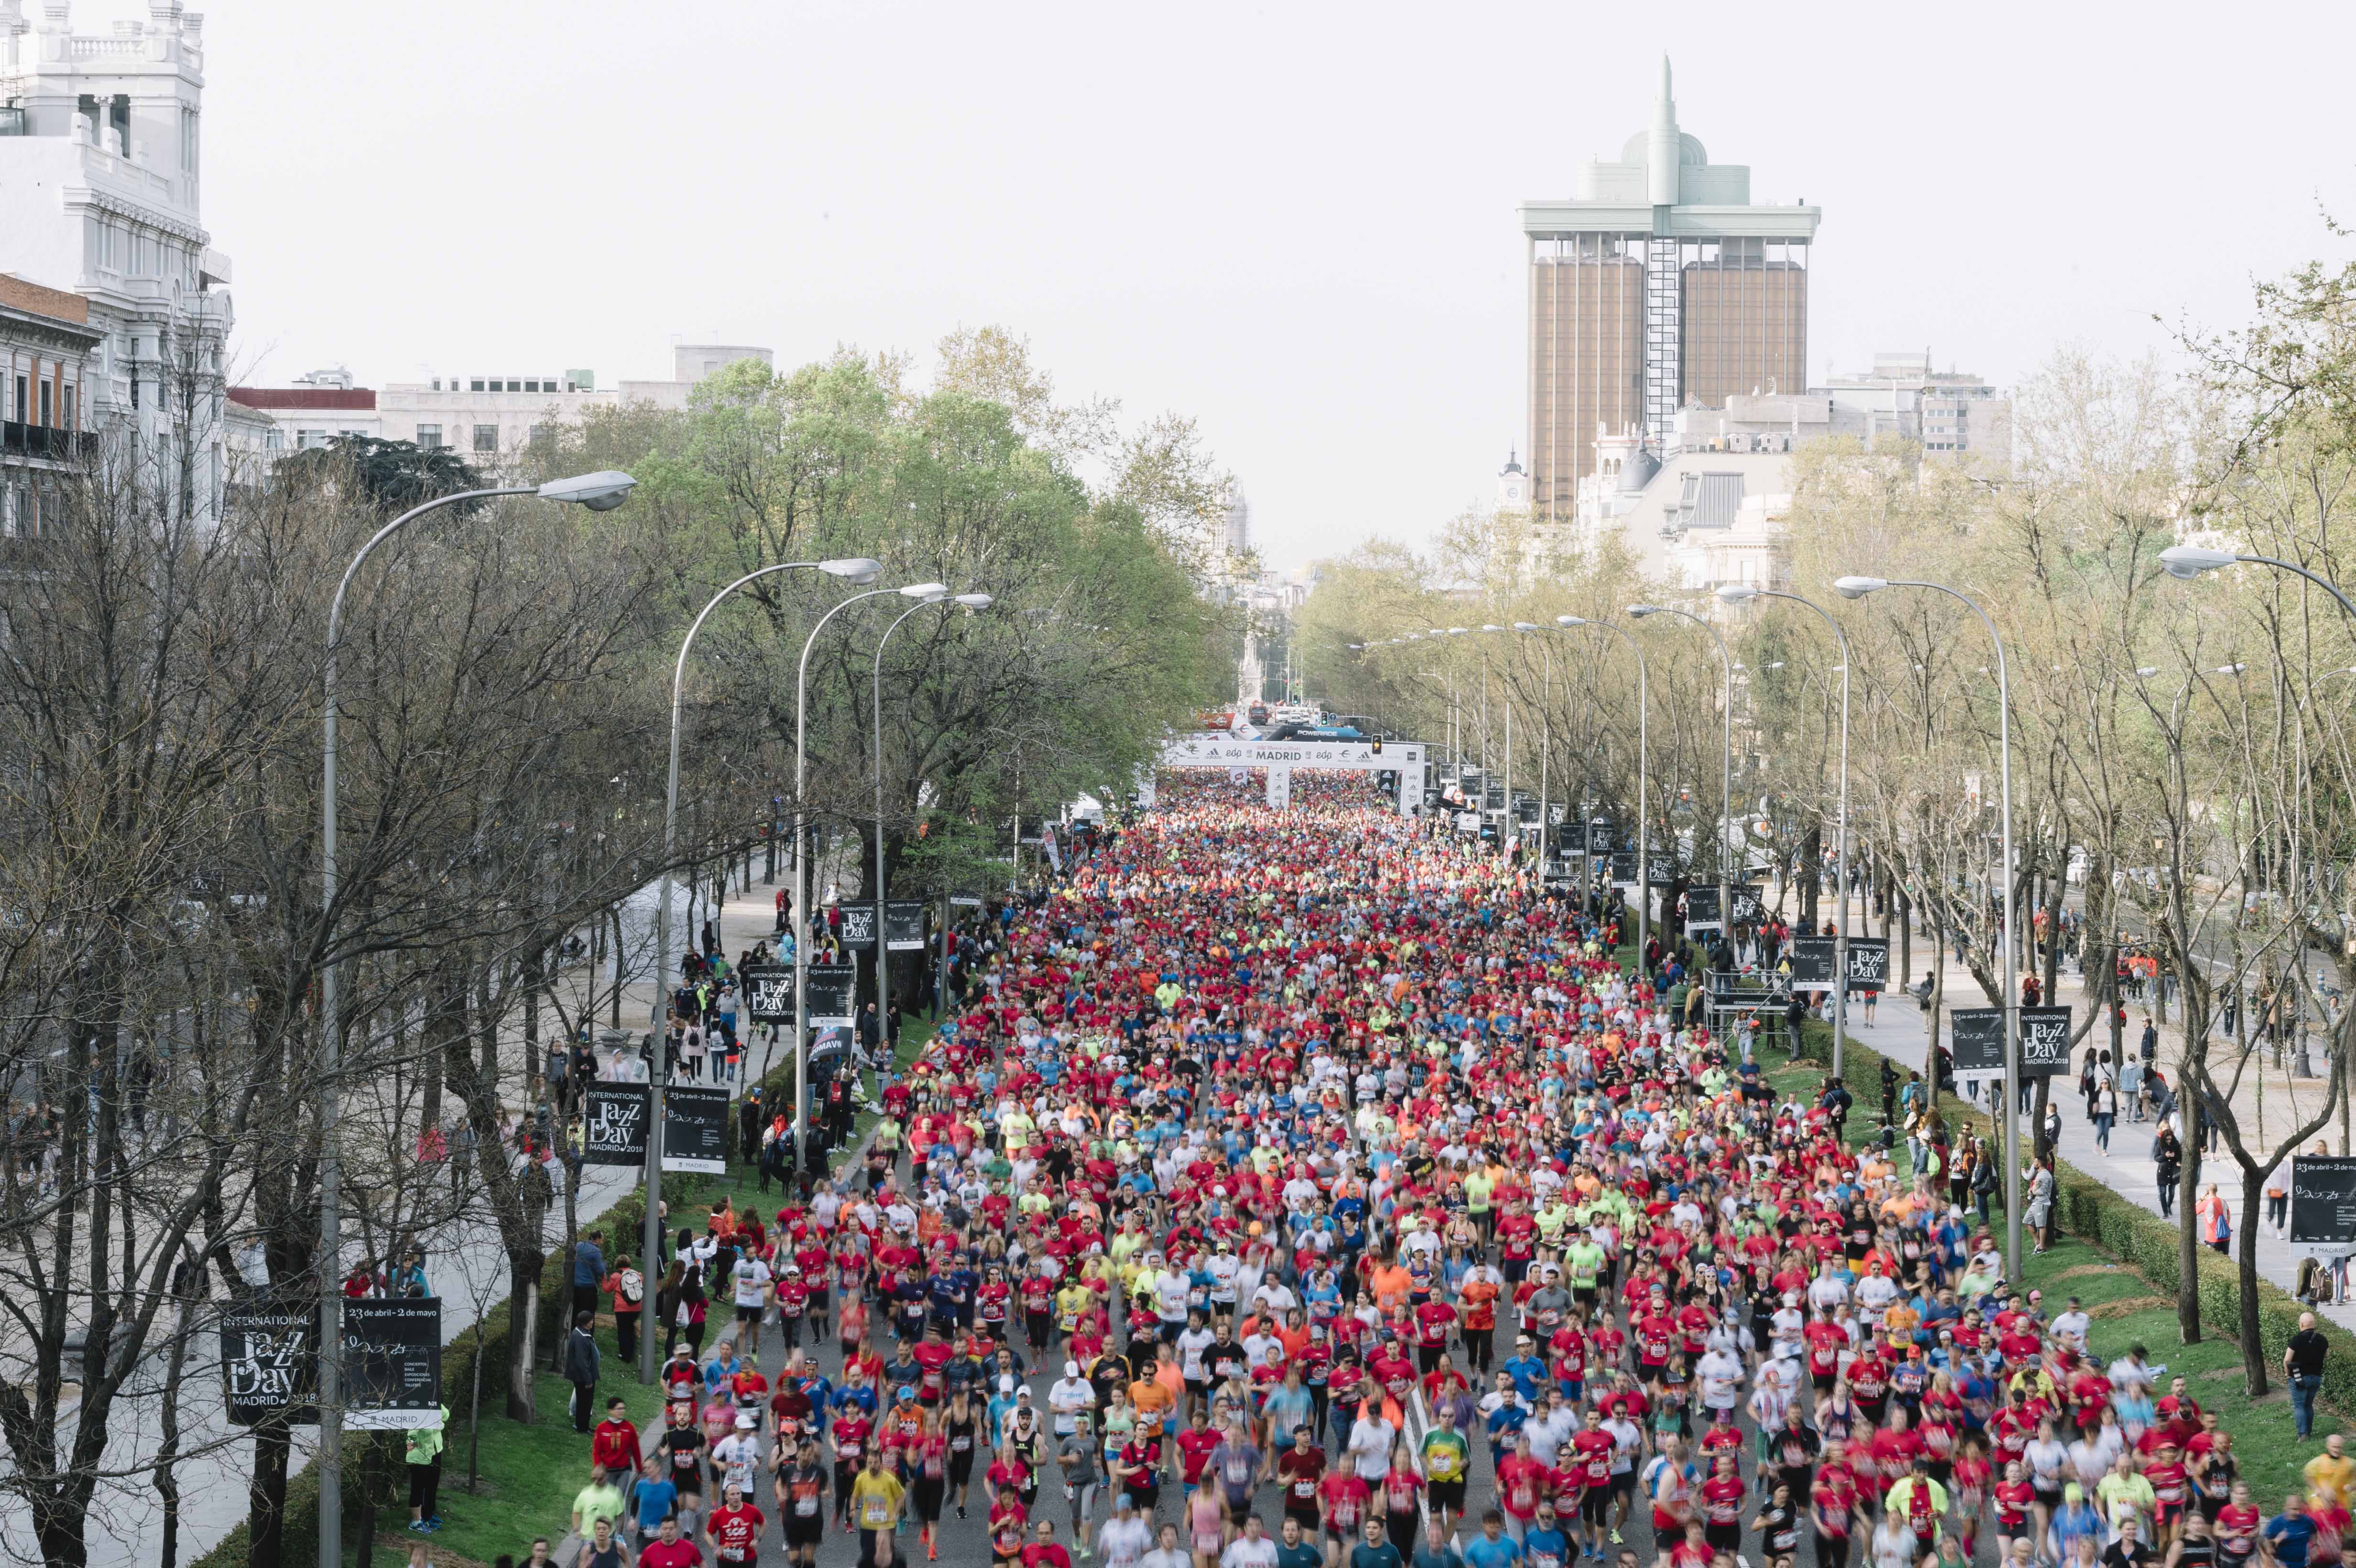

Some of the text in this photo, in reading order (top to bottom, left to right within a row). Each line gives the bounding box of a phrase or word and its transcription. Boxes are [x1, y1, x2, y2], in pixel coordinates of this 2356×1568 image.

[1226, 748, 1242, 760] edp
[1256, 751, 1301, 761] MADRID
[1316, 750, 1332, 762] edp
[845, 912, 873, 930] Jazz
[841, 923, 869, 942] Day
[1853, 950, 1884, 969] Jazz
[1849, 960, 1880, 982] Day
[756, 980, 789, 1001] Jazz
[751, 992, 785, 1016] Day
[2028, 1023, 2065, 1048] Jazz
[2023, 1037, 2061, 1064] Day
[589, 1092, 644, 1100] INTERNATIONAL
[595, 1102, 641, 1130] Jazz
[589, 1118, 635, 1152] Day
[2296, 1164, 2307, 1172] 23
[224, 1315, 310, 1327] INTERNATIONAL
[349, 1308, 363, 1320] 23
[397, 1308, 405, 1316] 2
[229, 1358, 299, 1404] Day
[233, 1395, 279, 1406] MADRID
